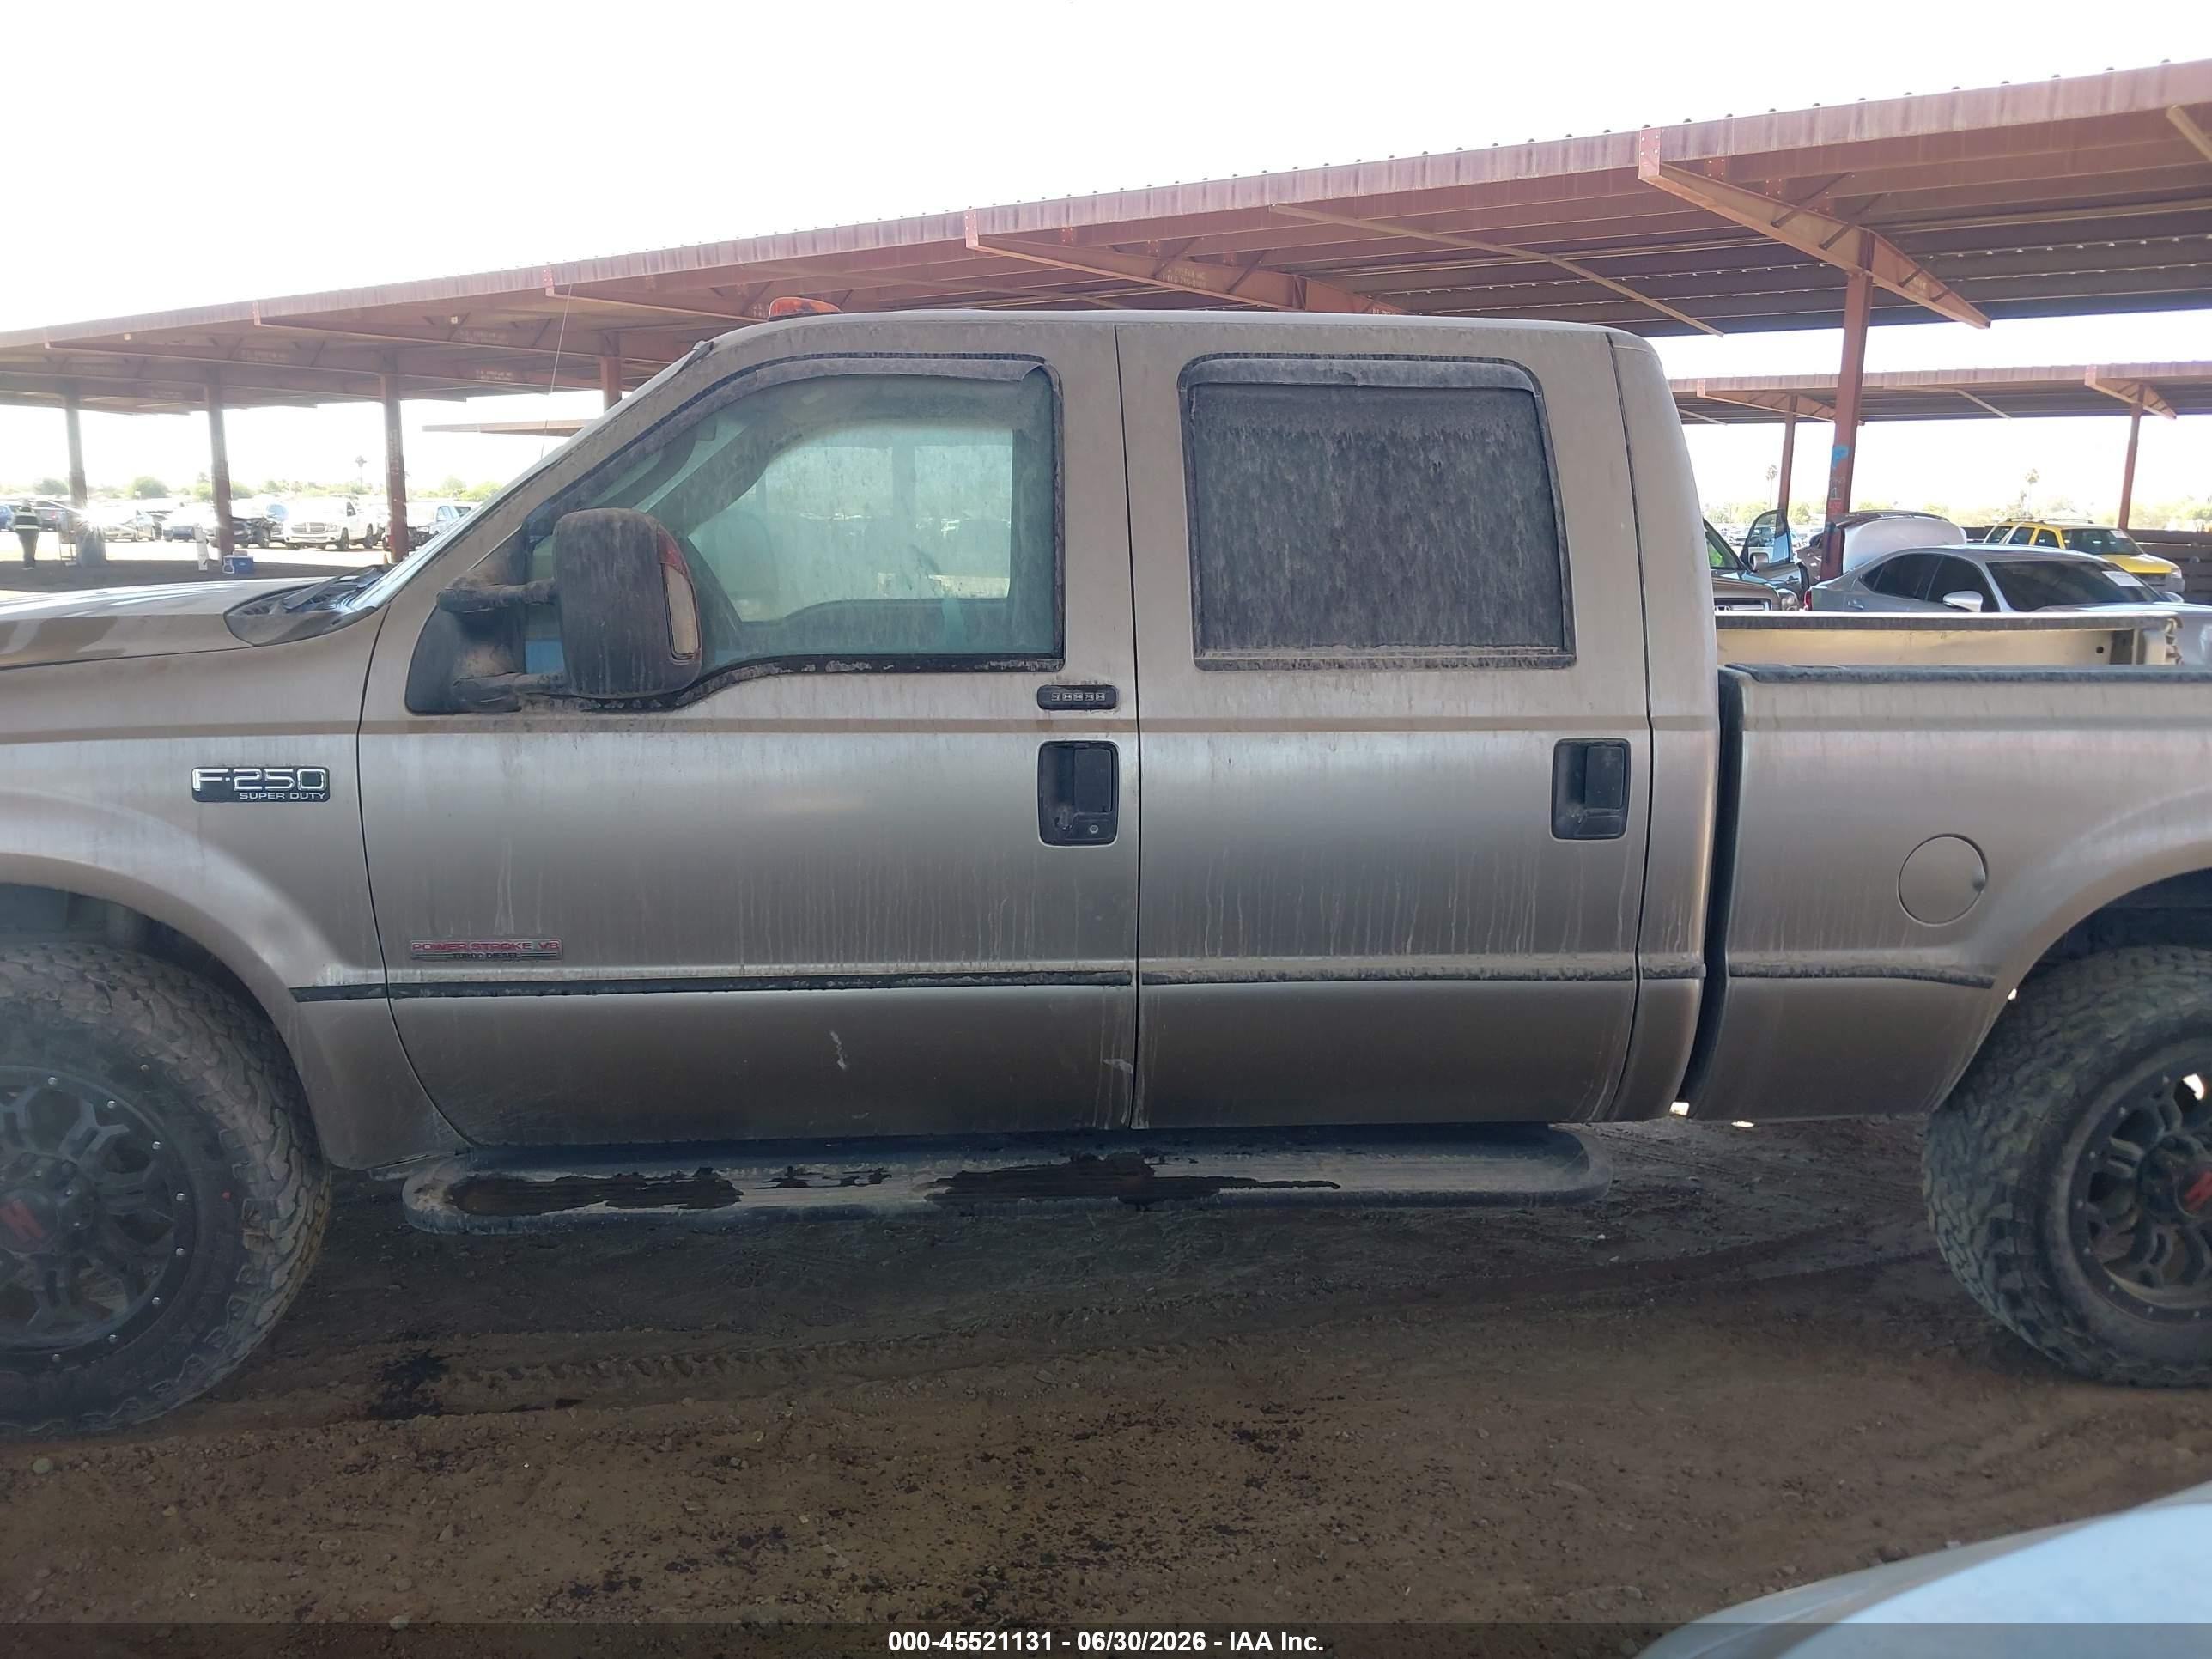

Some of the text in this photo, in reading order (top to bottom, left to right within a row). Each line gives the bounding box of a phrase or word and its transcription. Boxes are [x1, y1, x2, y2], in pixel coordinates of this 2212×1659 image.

[411, 940, 560, 951] POWER STROKE V8
